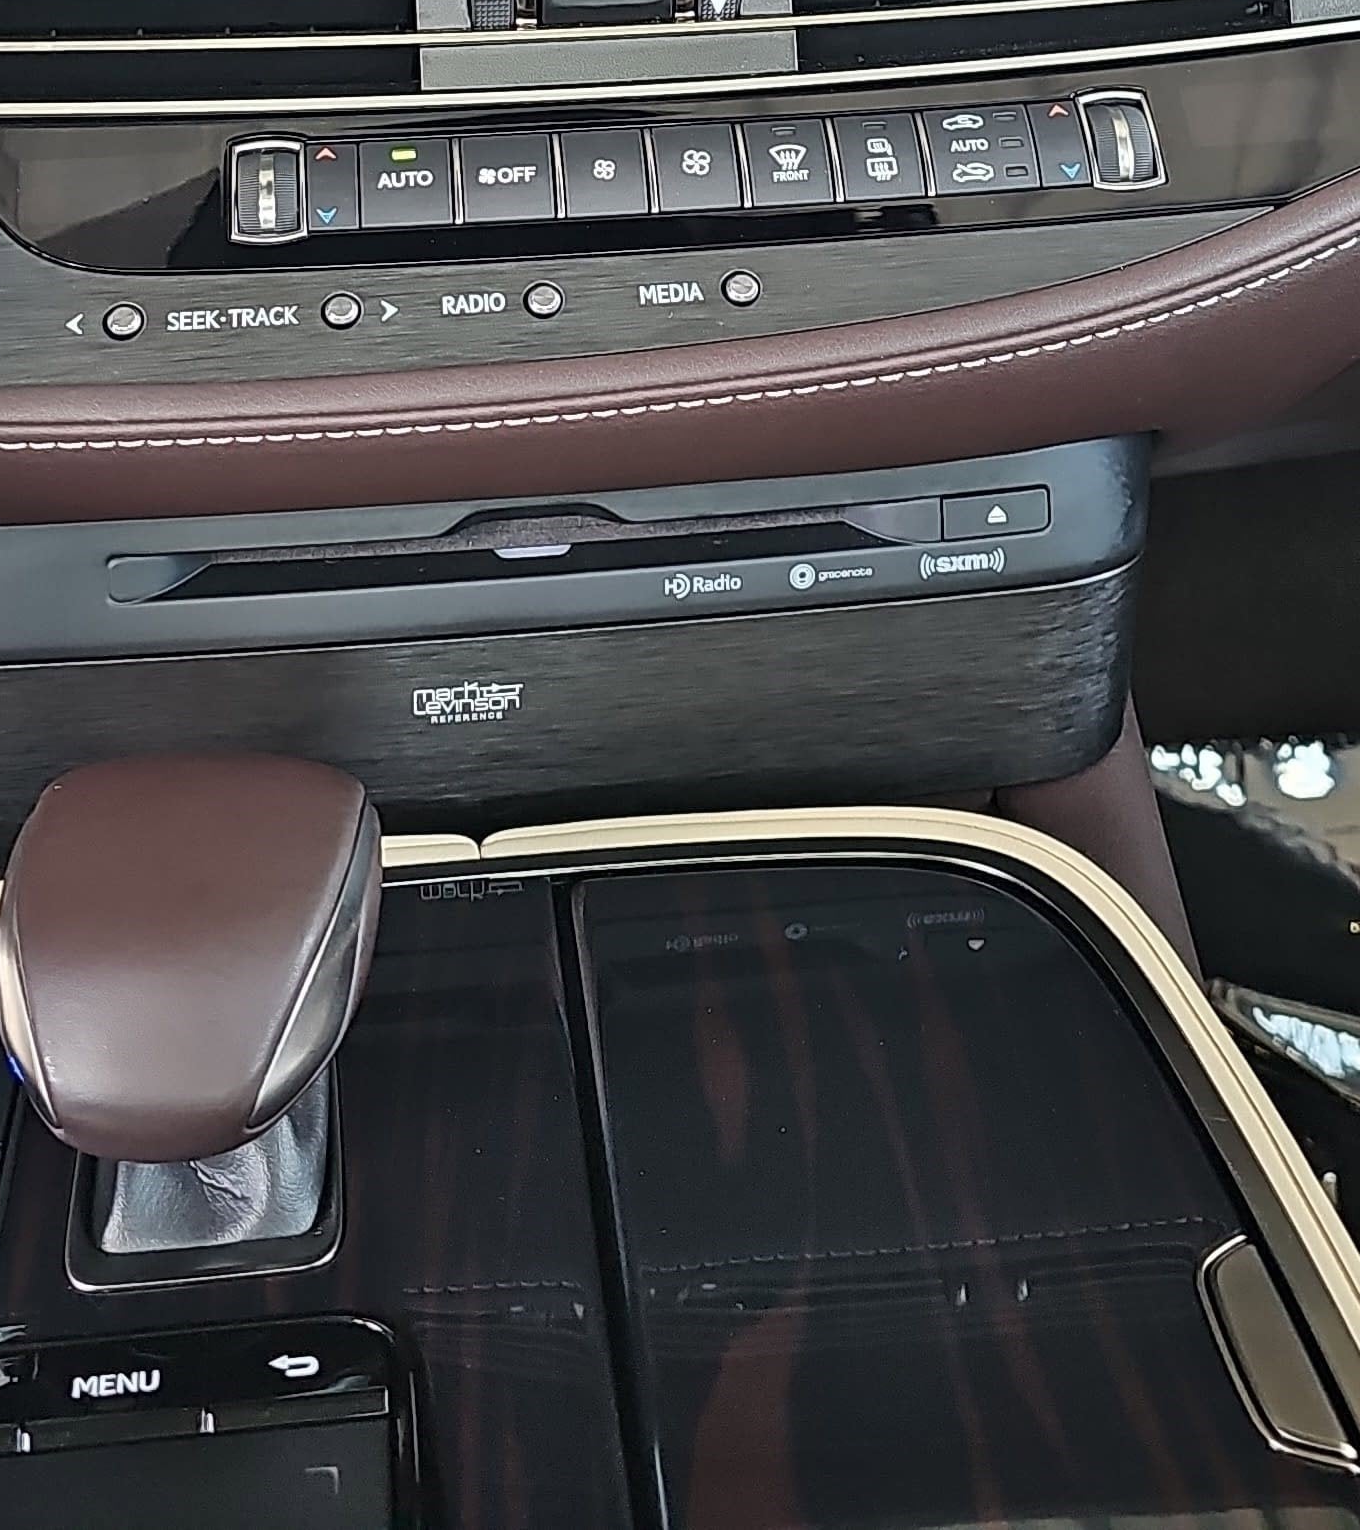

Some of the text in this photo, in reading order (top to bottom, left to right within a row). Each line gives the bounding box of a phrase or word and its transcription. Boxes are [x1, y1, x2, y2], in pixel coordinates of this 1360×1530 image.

[950, 137, 989, 153] AUTO
[377, 170, 434, 189] AUTO
[497, 166, 537, 184] OFF
[772, 169, 810, 183] FRONT
[639, 282, 705, 306] MEDIA
[441, 292, 506, 316] RADIO
[692, 574, 742, 594] Radio
[430, 710, 504, 725] REFERENCE
[71, 1368, 161, 1399] MENU
